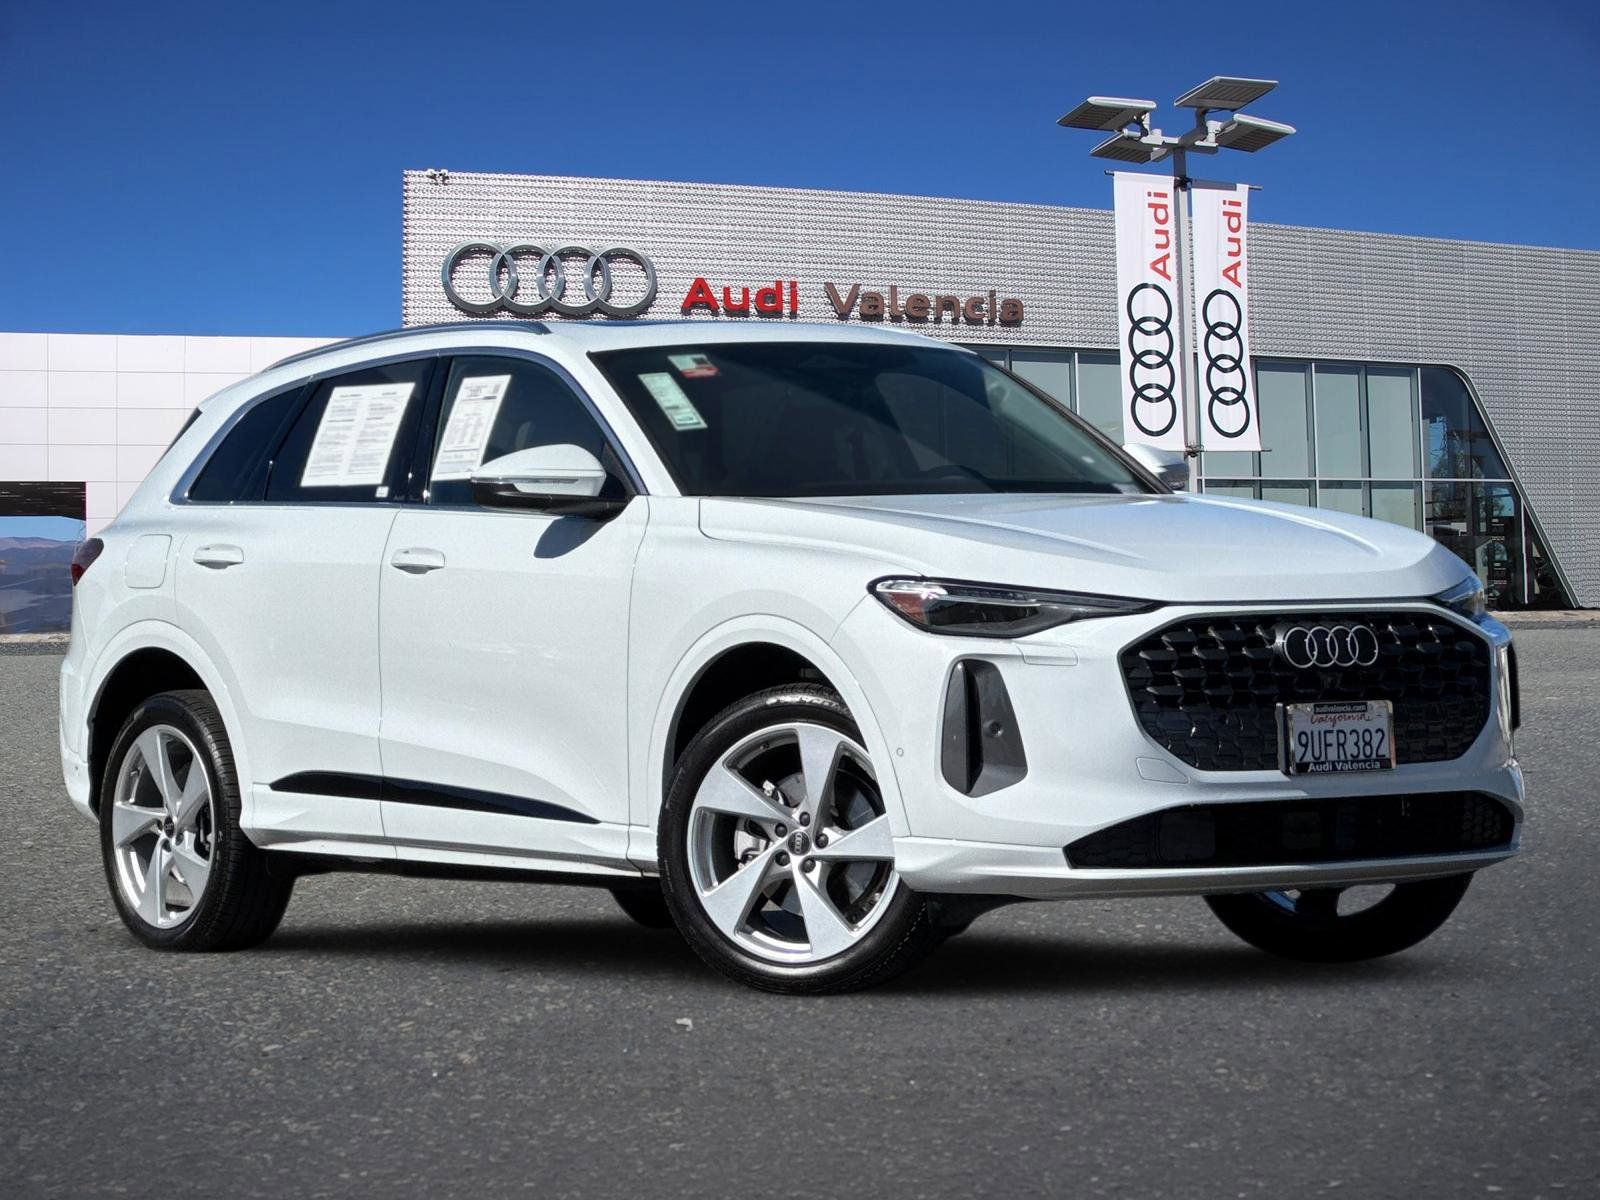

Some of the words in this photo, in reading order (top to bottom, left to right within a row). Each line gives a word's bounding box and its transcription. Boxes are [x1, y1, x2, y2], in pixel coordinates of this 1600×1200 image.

[1147, 191, 1172, 281] Audi
[1222, 199, 1242, 288] Audi
[681, 277, 799, 316] Audi
[824, 282, 1025, 326] Valencia
[1311, 713, 1370, 727] California
[1298, 728, 1386, 761] 9UFR382
[1309, 762, 1333, 773] Audi
[1335, 761, 1381, 771] Valencia
